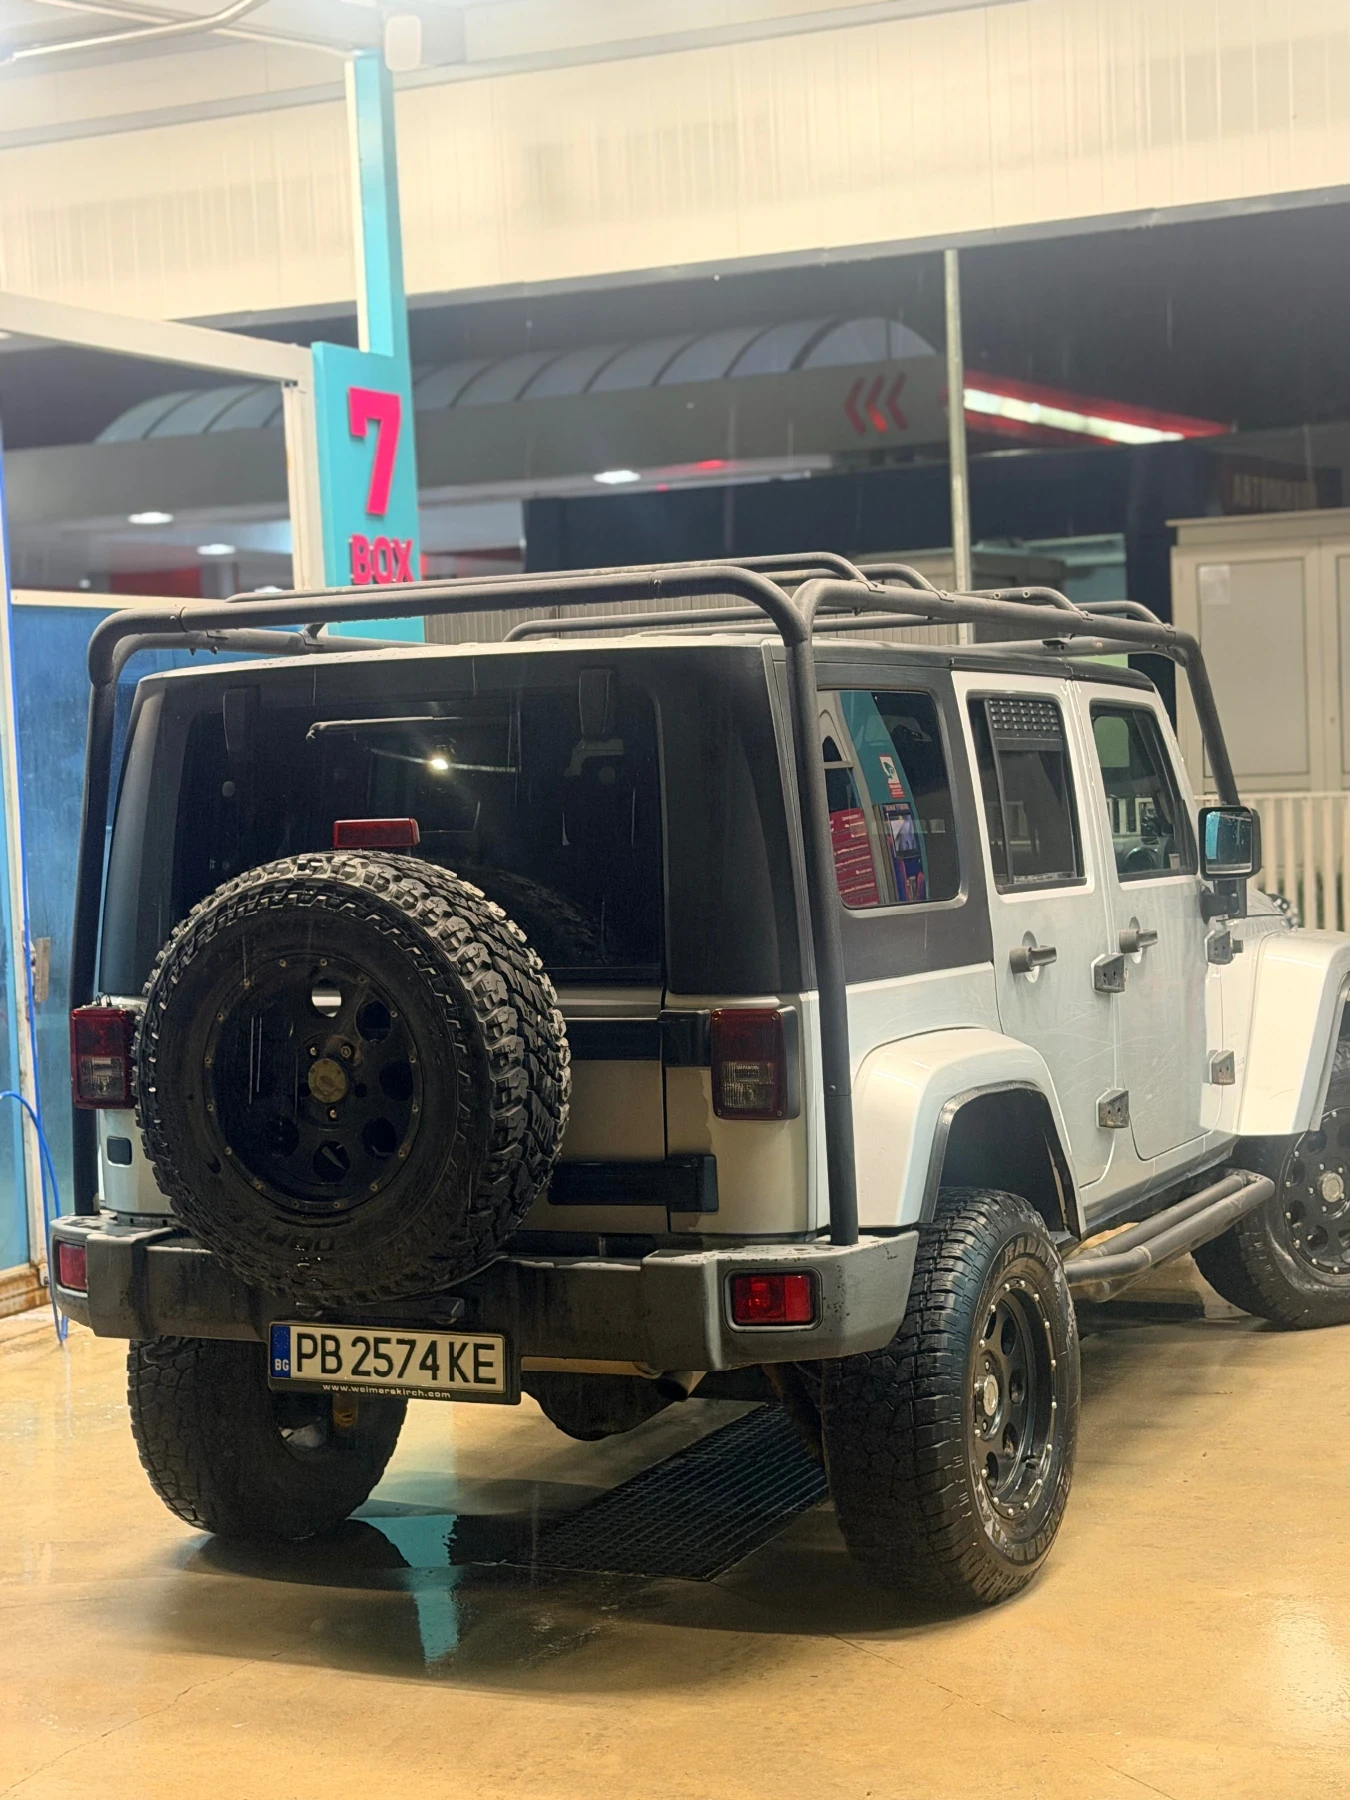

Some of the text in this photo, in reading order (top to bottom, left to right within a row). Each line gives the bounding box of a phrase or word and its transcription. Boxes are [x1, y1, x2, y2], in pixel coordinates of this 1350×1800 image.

[348, 386, 402, 515] 7
[350, 533, 414, 585] BOX
[274, 1358, 290, 1371] BG
[296, 1332, 496, 1384] PB 2574 KE
[322, 1383, 451, 1399] www.weimerskirch.com
